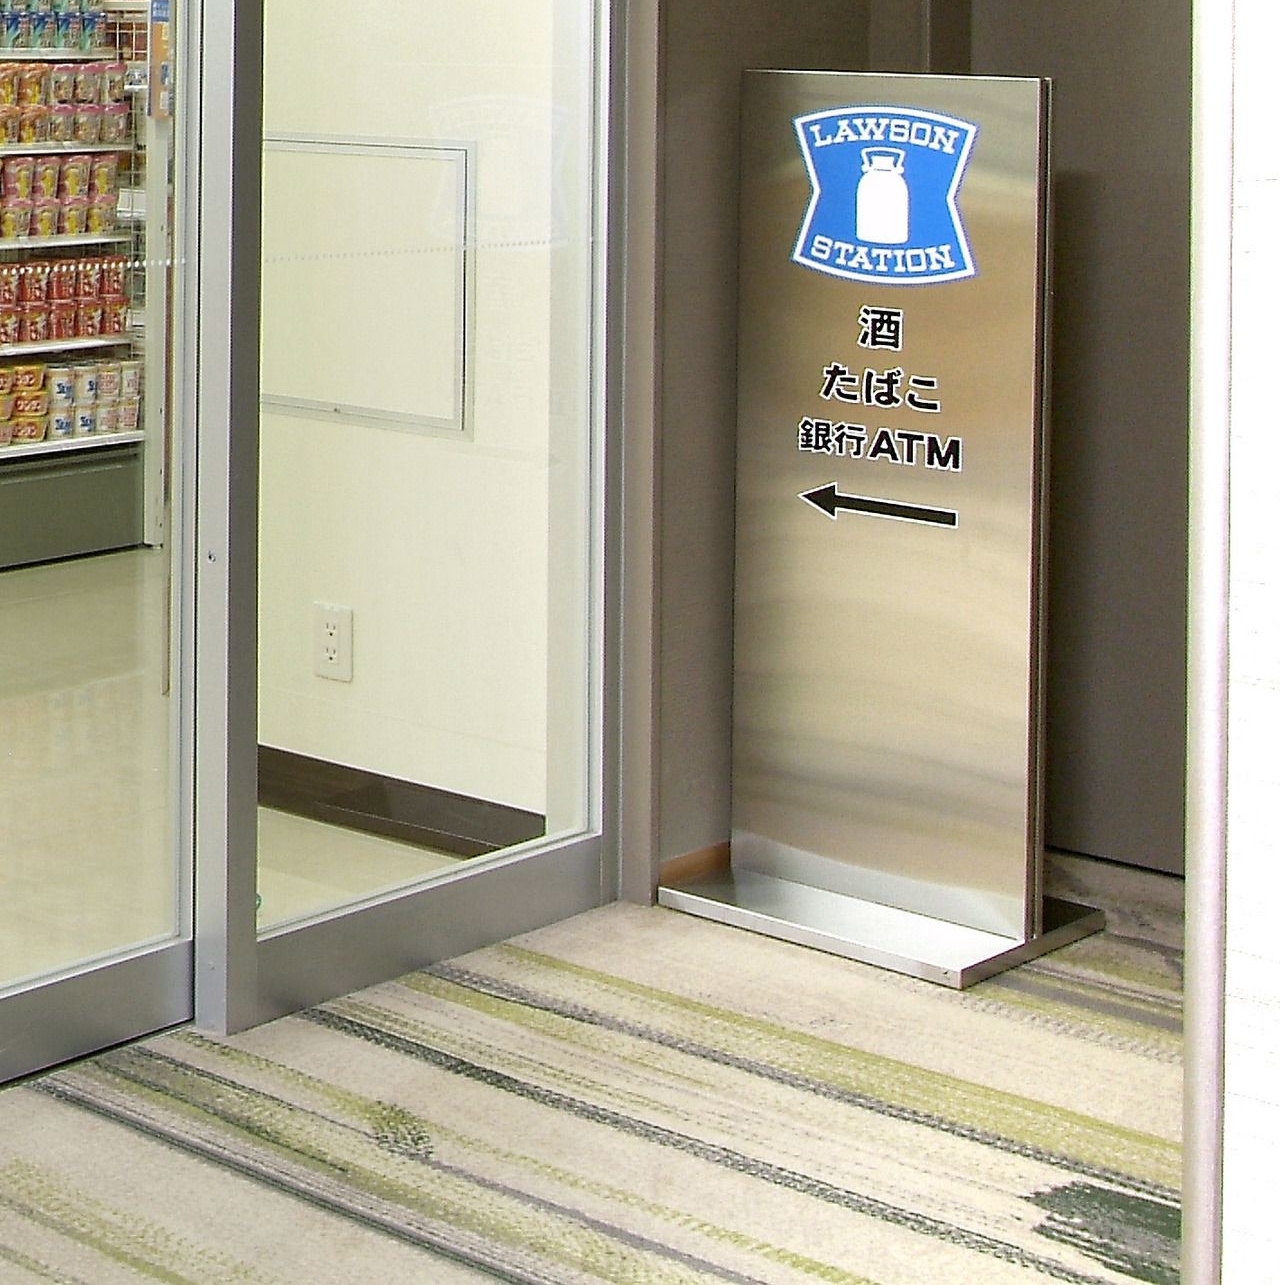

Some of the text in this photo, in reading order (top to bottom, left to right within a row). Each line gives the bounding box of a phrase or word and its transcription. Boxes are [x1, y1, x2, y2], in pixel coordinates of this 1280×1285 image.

[810, 118, 959, 156] LAWSON
[810, 237, 956, 274] STATION
[857, 305, 904, 351] 酒
[820, 364, 942, 413] たばこ
[796, 419, 963, 471] 銀行ATM
